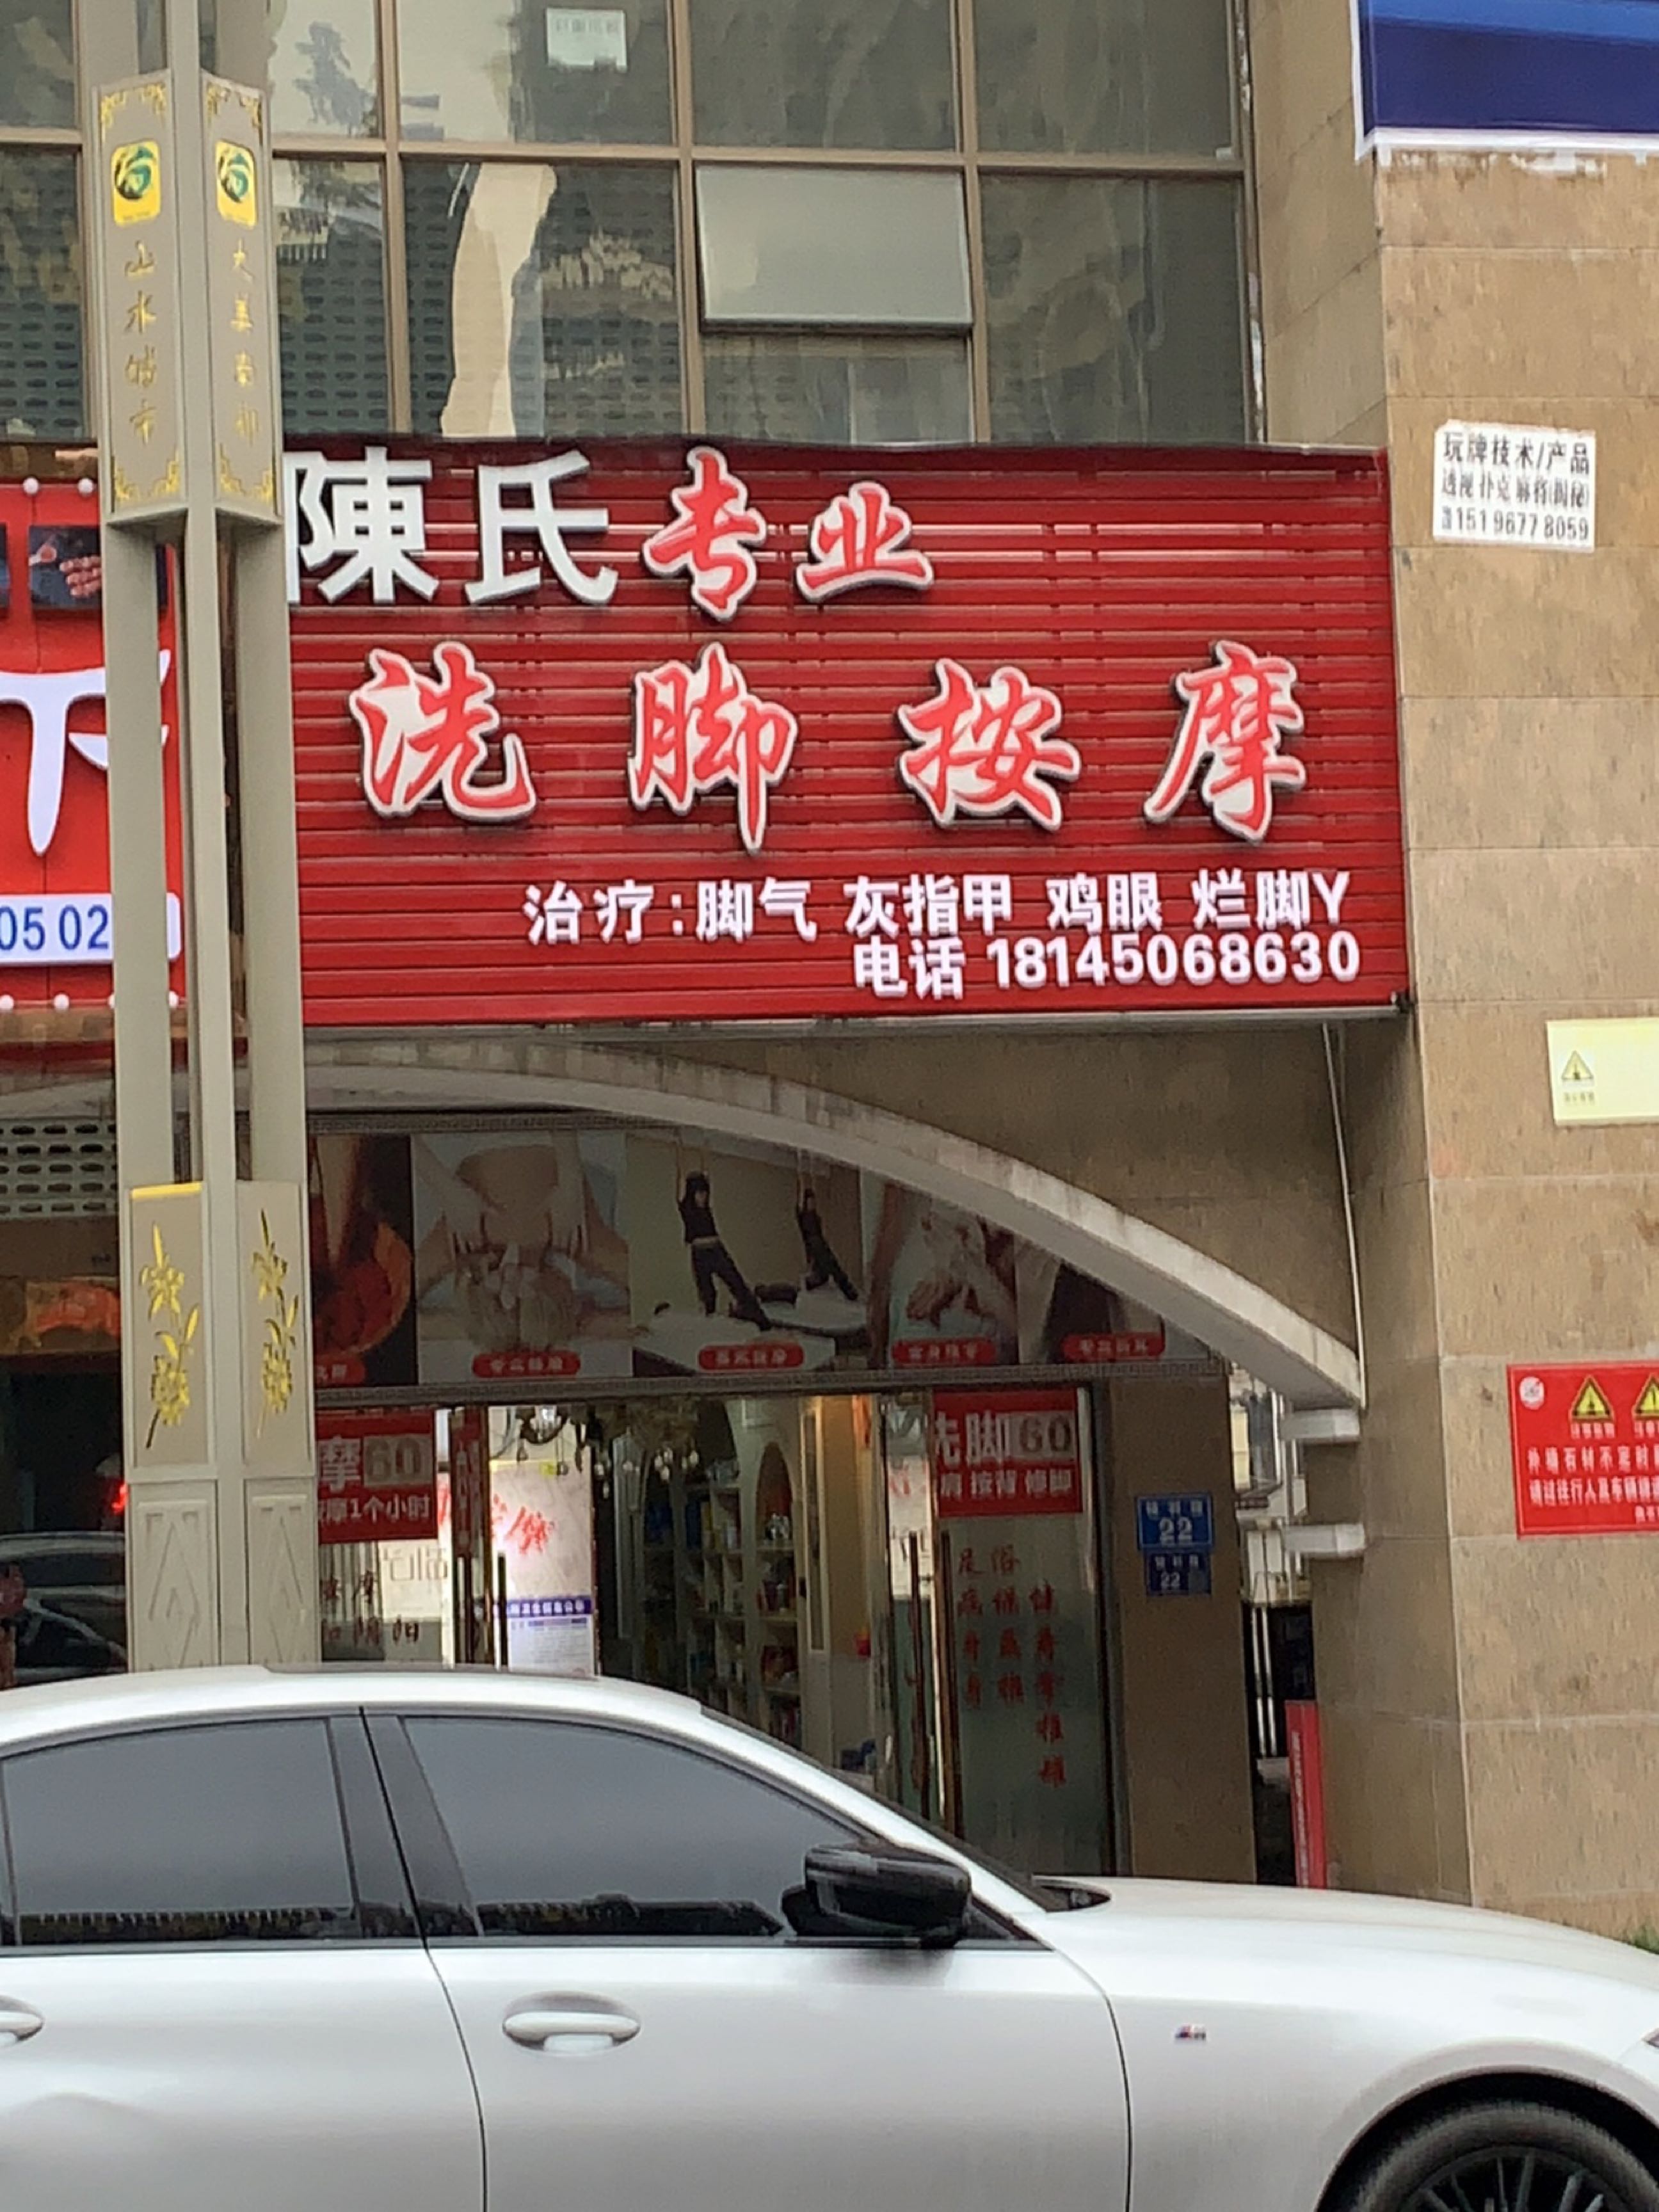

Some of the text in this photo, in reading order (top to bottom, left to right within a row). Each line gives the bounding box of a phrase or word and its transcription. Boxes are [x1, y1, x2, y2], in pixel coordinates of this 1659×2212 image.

[349, 639, 1307, 856] 洗脚按摩
[843, 872, 1013, 938] 灰指甲
[1046, 871, 1164, 934] 鸡眼
[853, 930, 1360, 1002] 电话 18145068630
[1159, 1517, 1194, 1545] 22
